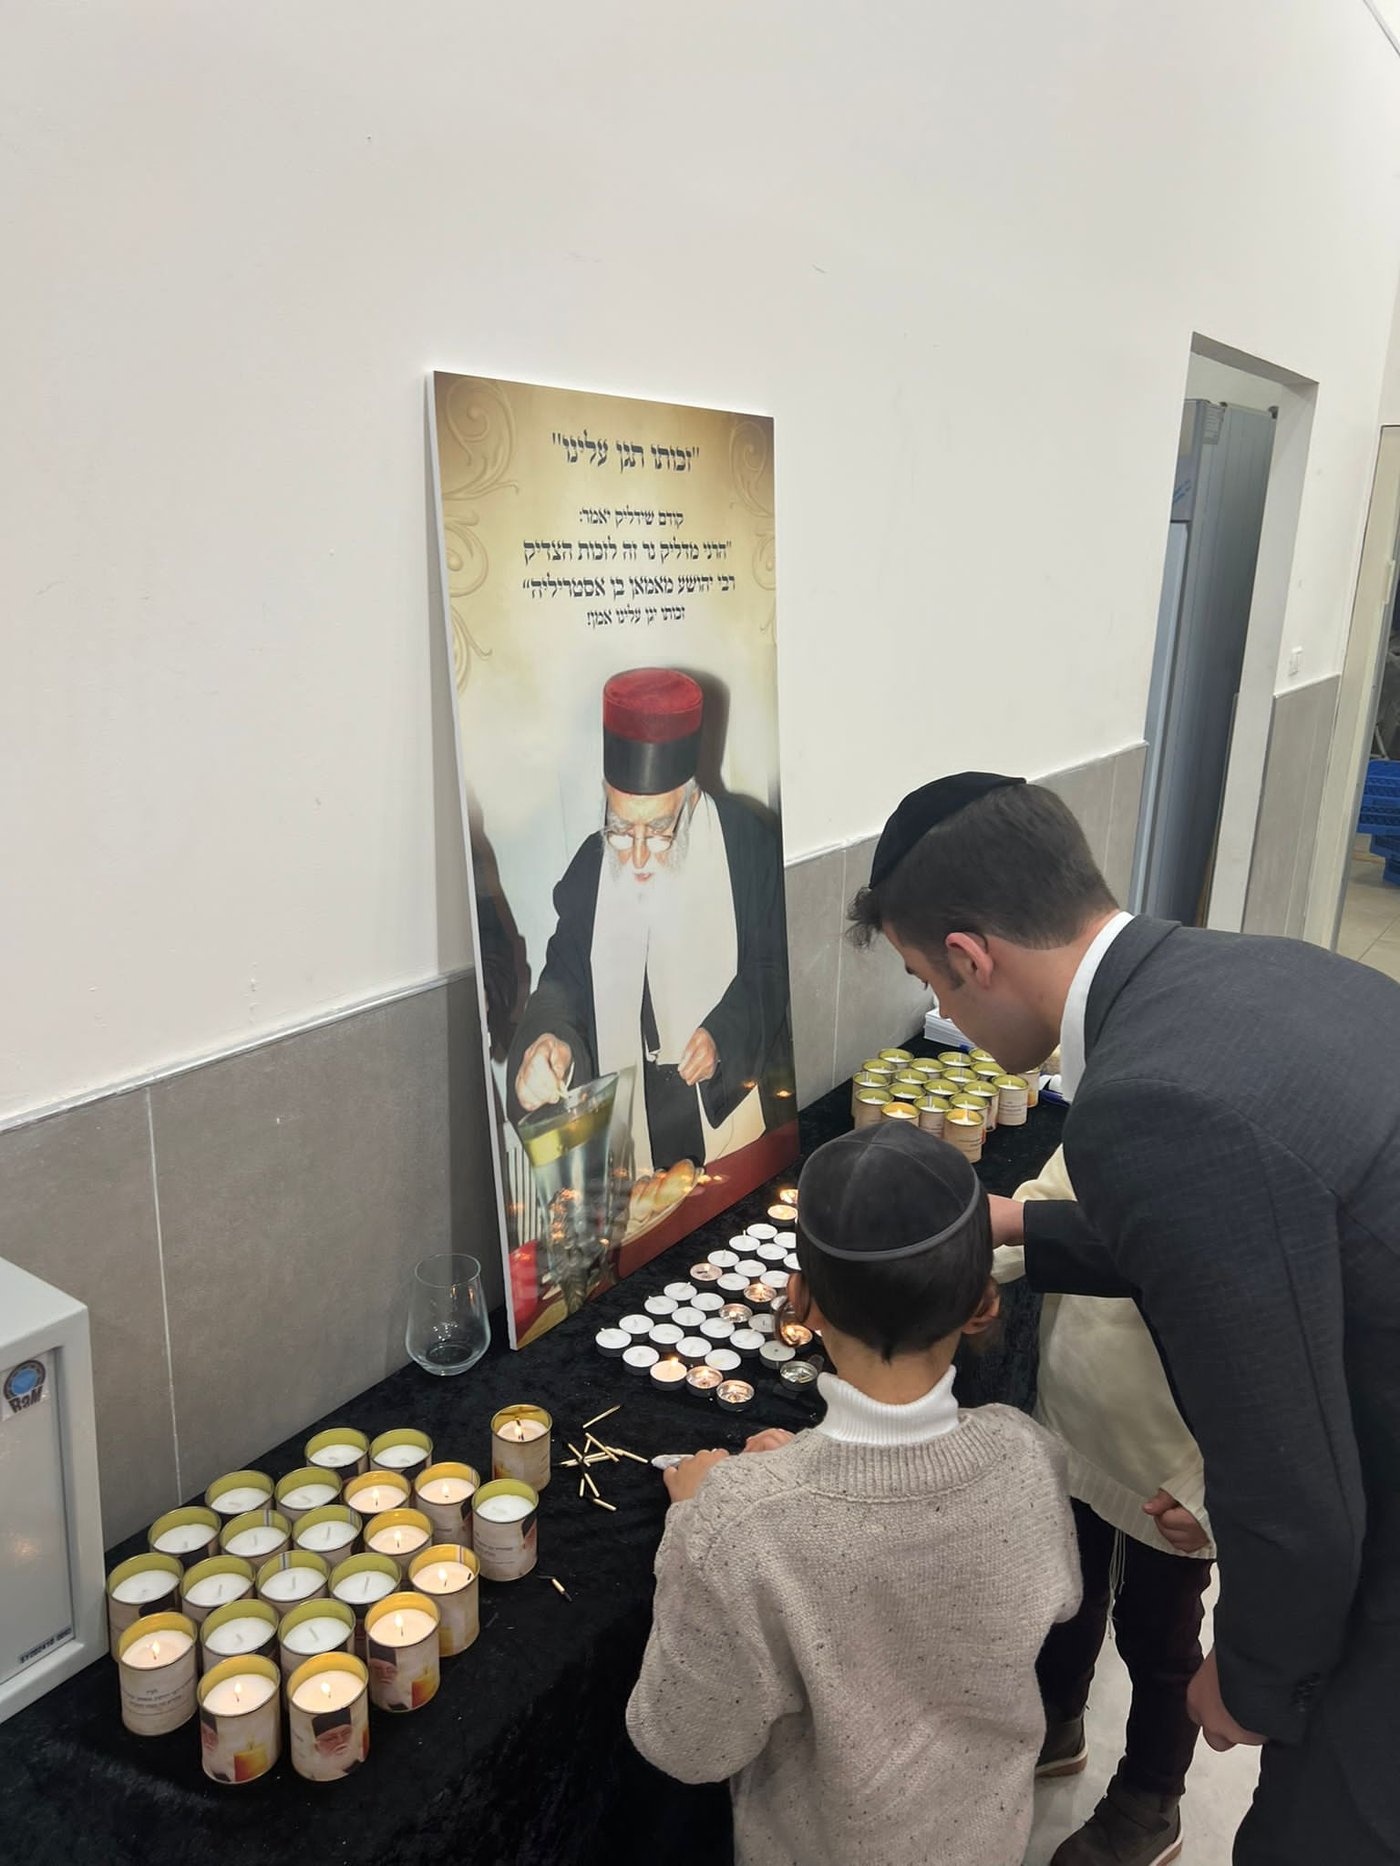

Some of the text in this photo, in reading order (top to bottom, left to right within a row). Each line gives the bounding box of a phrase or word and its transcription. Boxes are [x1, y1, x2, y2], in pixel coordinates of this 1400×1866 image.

[553, 429, 699, 473] "זכותו תגן עלינו"
[580, 504, 684, 529] קודם שידליק יאמר:
[523, 539, 572, 566] הצדיק
[578, 535, 617, 560] לזכות
[623, 541, 637, 559] זה
[642, 541, 655, 559] נר
[660, 536, 699, 564] מדליק
[610, 576, 625, 601] בן
[629, 576, 673, 599] מאמאן
[678, 574, 713, 594] יהושע
[718, 574, 735, 591] רבי
[587, 609, 612, 629] אמן!
[616, 603, 641, 624] עלינו
[661, 605, 685, 620] זכותו
